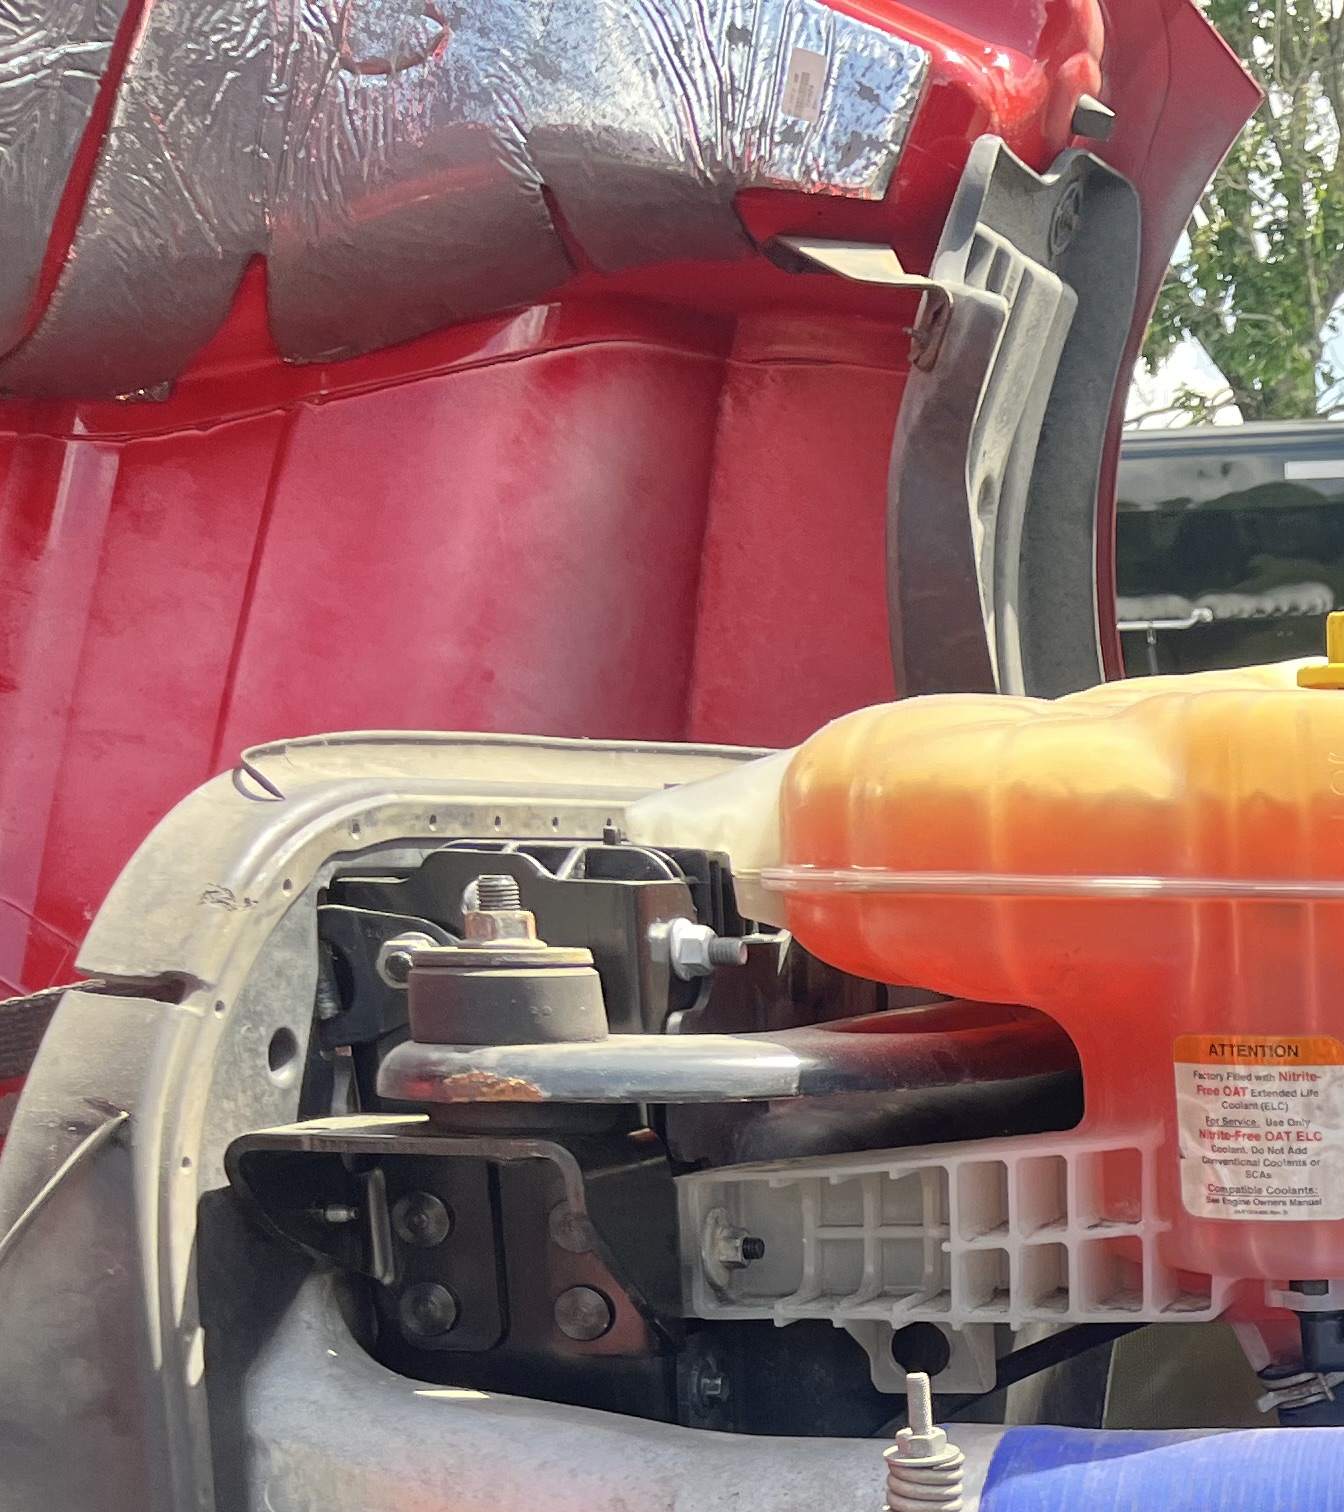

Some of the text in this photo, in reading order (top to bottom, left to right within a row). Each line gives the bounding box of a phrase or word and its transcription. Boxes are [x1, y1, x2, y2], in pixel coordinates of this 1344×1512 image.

[1209, 1043, 1299, 1058] ATTENTION
[1193, 1071, 1322, 1083] Factory Filled with Nitrite-
[1197, 1085, 1319, 1098] Free OAT Extended Life
[1221, 1101, 1289, 1112] Coolant (ELC)
[1206, 1116, 1311, 1129] For Service: Use Only
[1199, 1129, 1323, 1142] Nitrite-Free OAT ELC
[1251, 1146, 1264, 1155] Do
[1268, 1146, 1285, 1155] Not
[1288, 1146, 1308, 1155] Add
[1202, 1156, 1260, 1167] Conventional
[1263, 1159, 1307, 1168] Coolants
[1245, 1171, 1272, 1180] SCAs
[1207, 1184, 1263, 1196] Compatible
[1222, 1197, 1251, 1207] Engine
[1290, 1198, 1322, 1206] Manual
